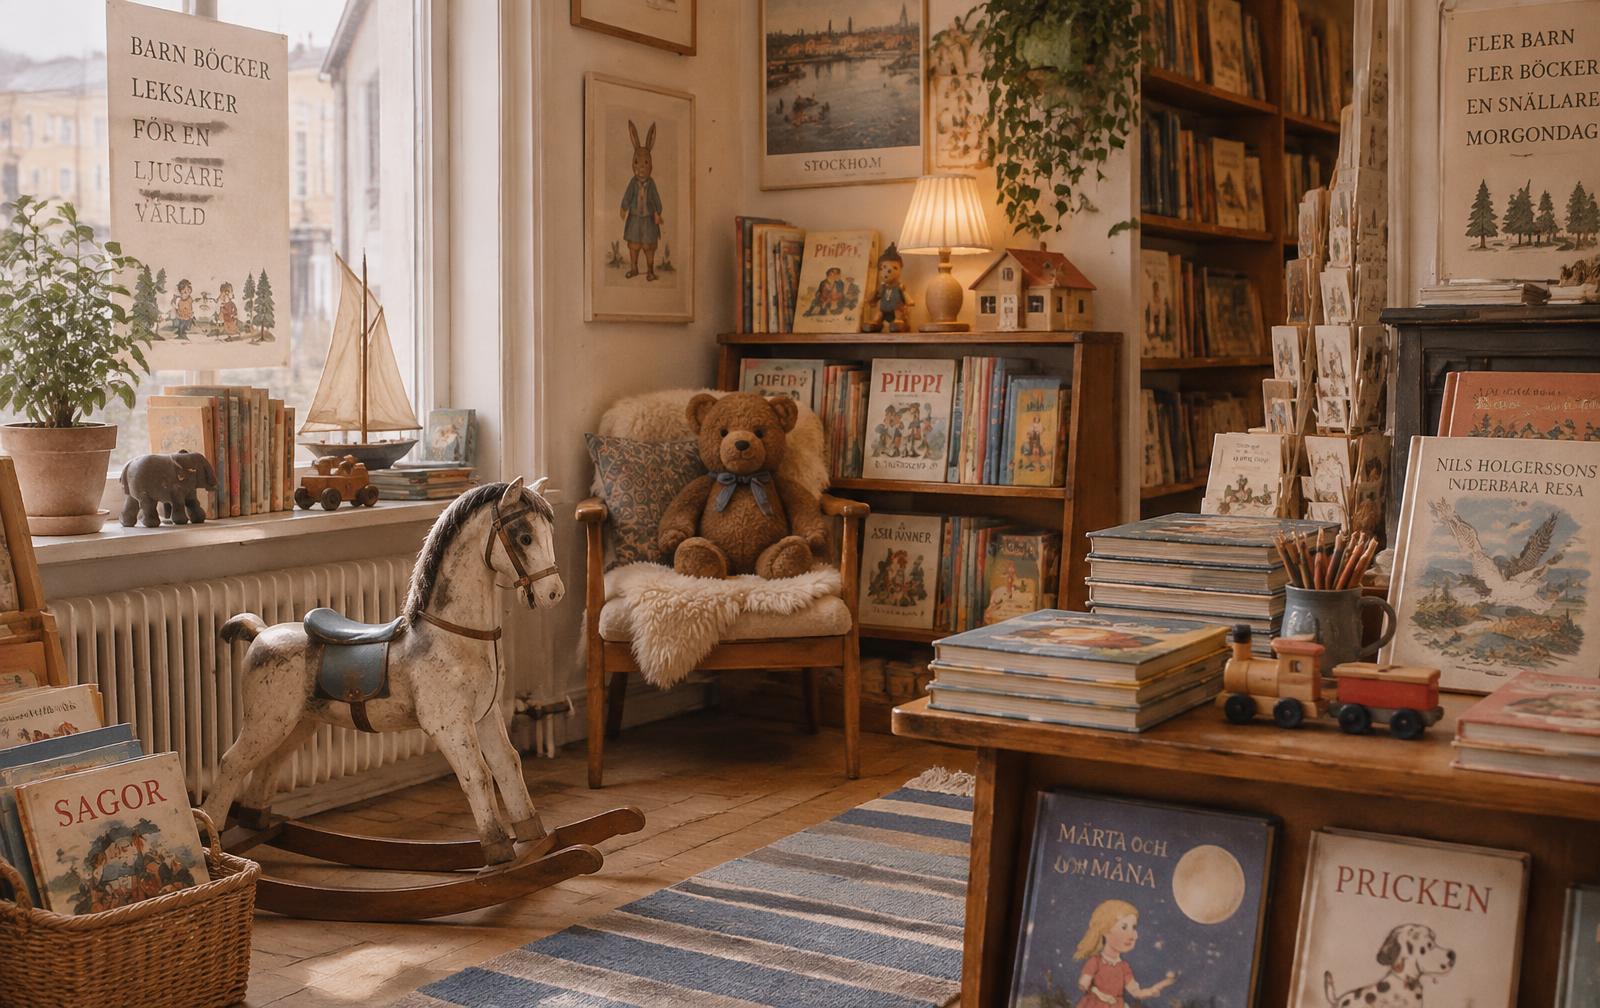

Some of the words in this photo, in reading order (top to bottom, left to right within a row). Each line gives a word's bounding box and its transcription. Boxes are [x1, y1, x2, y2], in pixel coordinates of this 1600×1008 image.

[1467, 33, 1515, 53] FLER
[1521, 28, 1575, 48] BARN
[130, 35, 187, 64] BARN
[193, 48, 271, 81] BÖCKER
[1467, 65, 1514, 84] FLER
[1520, 59, 1600, 80] BÖCKER
[131, 77, 238, 114] LEKSAKER
[1466, 97, 1493, 115] EN
[1498, 91, 1600, 113] SNÄLLARE
[132, 116, 177, 143] FÖR
[183, 125, 210, 147] EN
[1466, 122, 1599, 147] MORGONDAG
[134, 160, 225, 188] LJUSARE
[134, 200, 206, 226] VÄRLD
[1436, 457, 1473, 472] NILS
[1478, 459, 1598, 479] HOLGERSSONS
[1544, 481, 1585, 497] RESA
[53, 779, 168, 828] SAGOR
[1056, 822, 1127, 851] MÄRTA
[1131, 836, 1169, 858] OCH
[1090, 856, 1157, 889] MÅNA
[1336, 865, 1493, 915] PRICKEN
